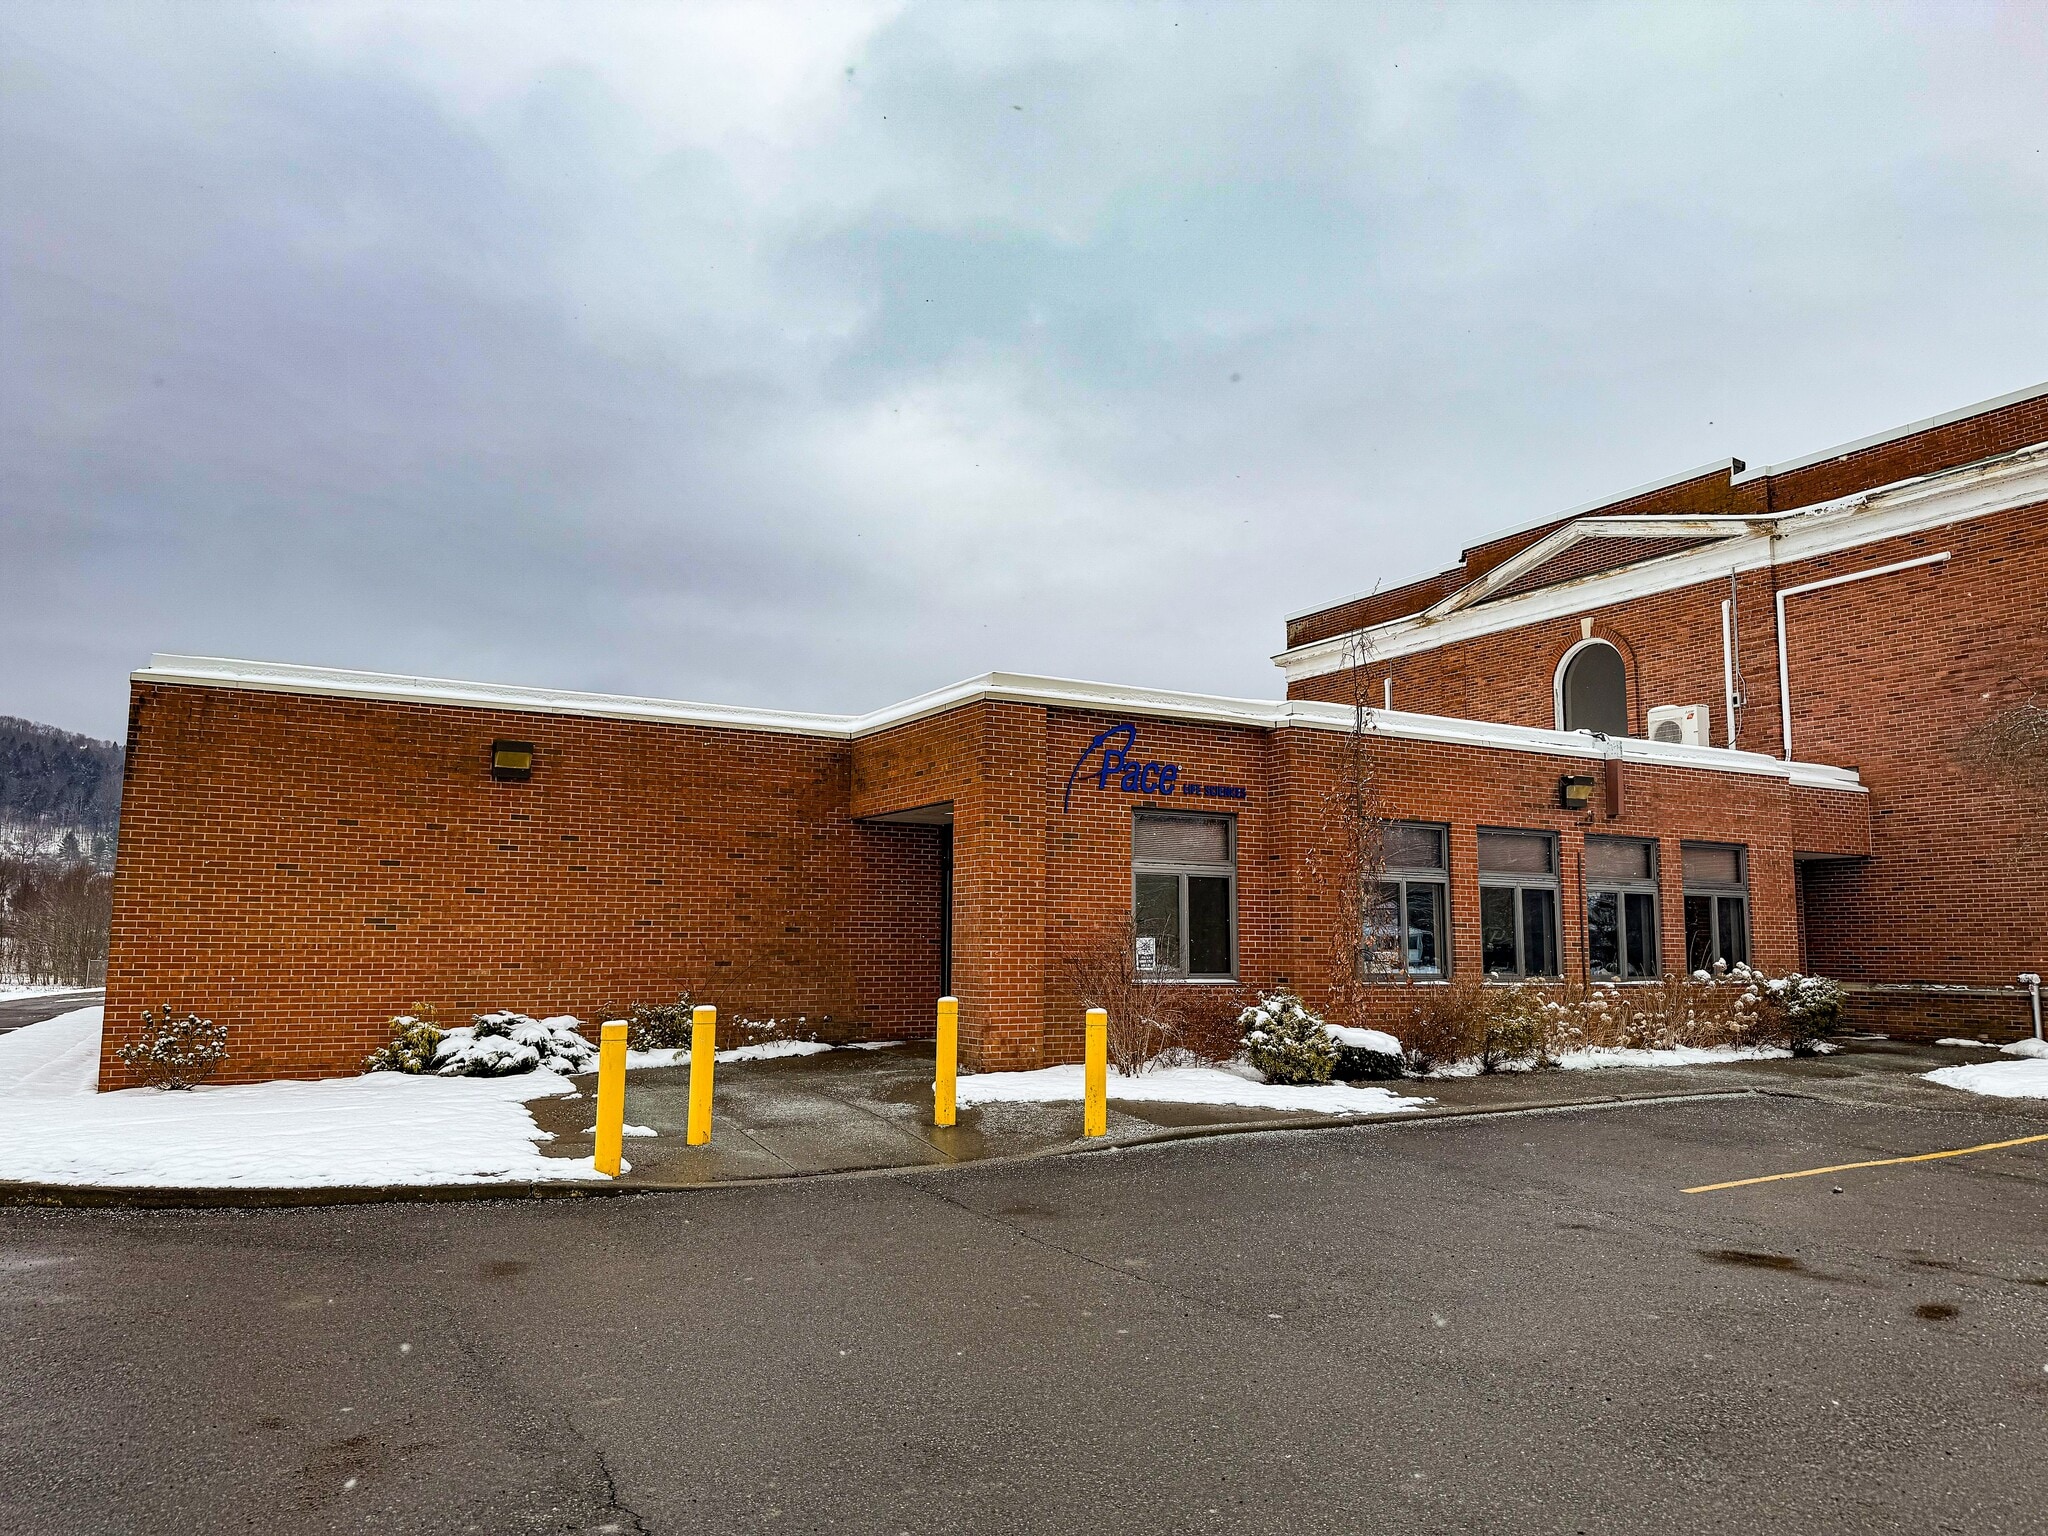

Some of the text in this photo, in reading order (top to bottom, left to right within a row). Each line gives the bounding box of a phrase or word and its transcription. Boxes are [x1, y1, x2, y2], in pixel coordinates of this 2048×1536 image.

[1099, 749, 1247, 798] Pace LIFE SCIENCES
